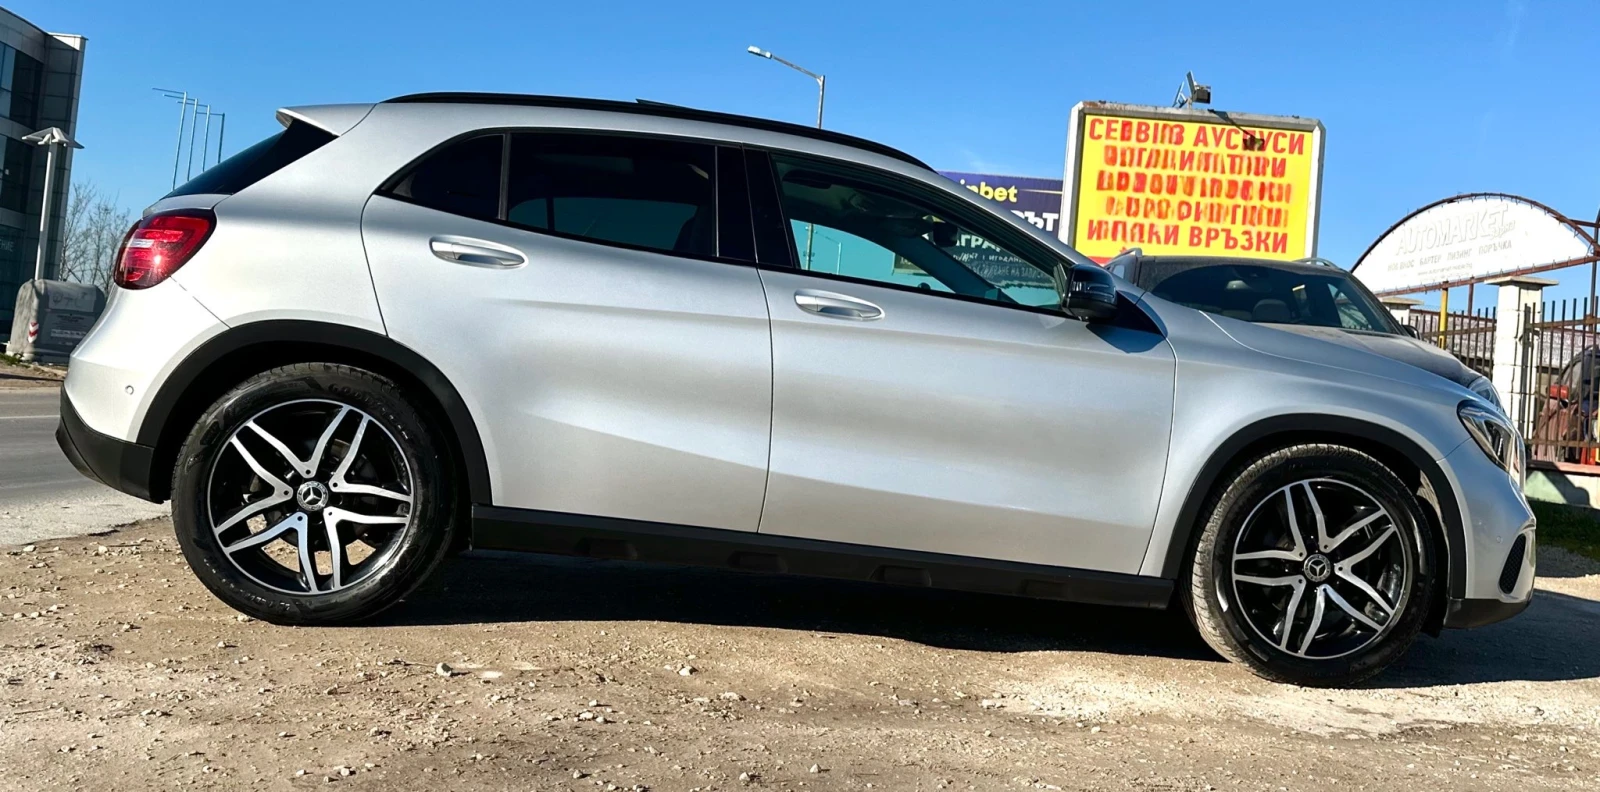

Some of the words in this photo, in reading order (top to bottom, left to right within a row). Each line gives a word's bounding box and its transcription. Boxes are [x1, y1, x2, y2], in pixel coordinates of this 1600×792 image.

[1188, 226, 1288, 254] ВРЪЗКИ
[1396, 203, 1509, 256] AUTOMARKET
[1419, 254, 1442, 267] БАРТЕР
[1478, 240, 1513, 256] ПОРЪЧКА
